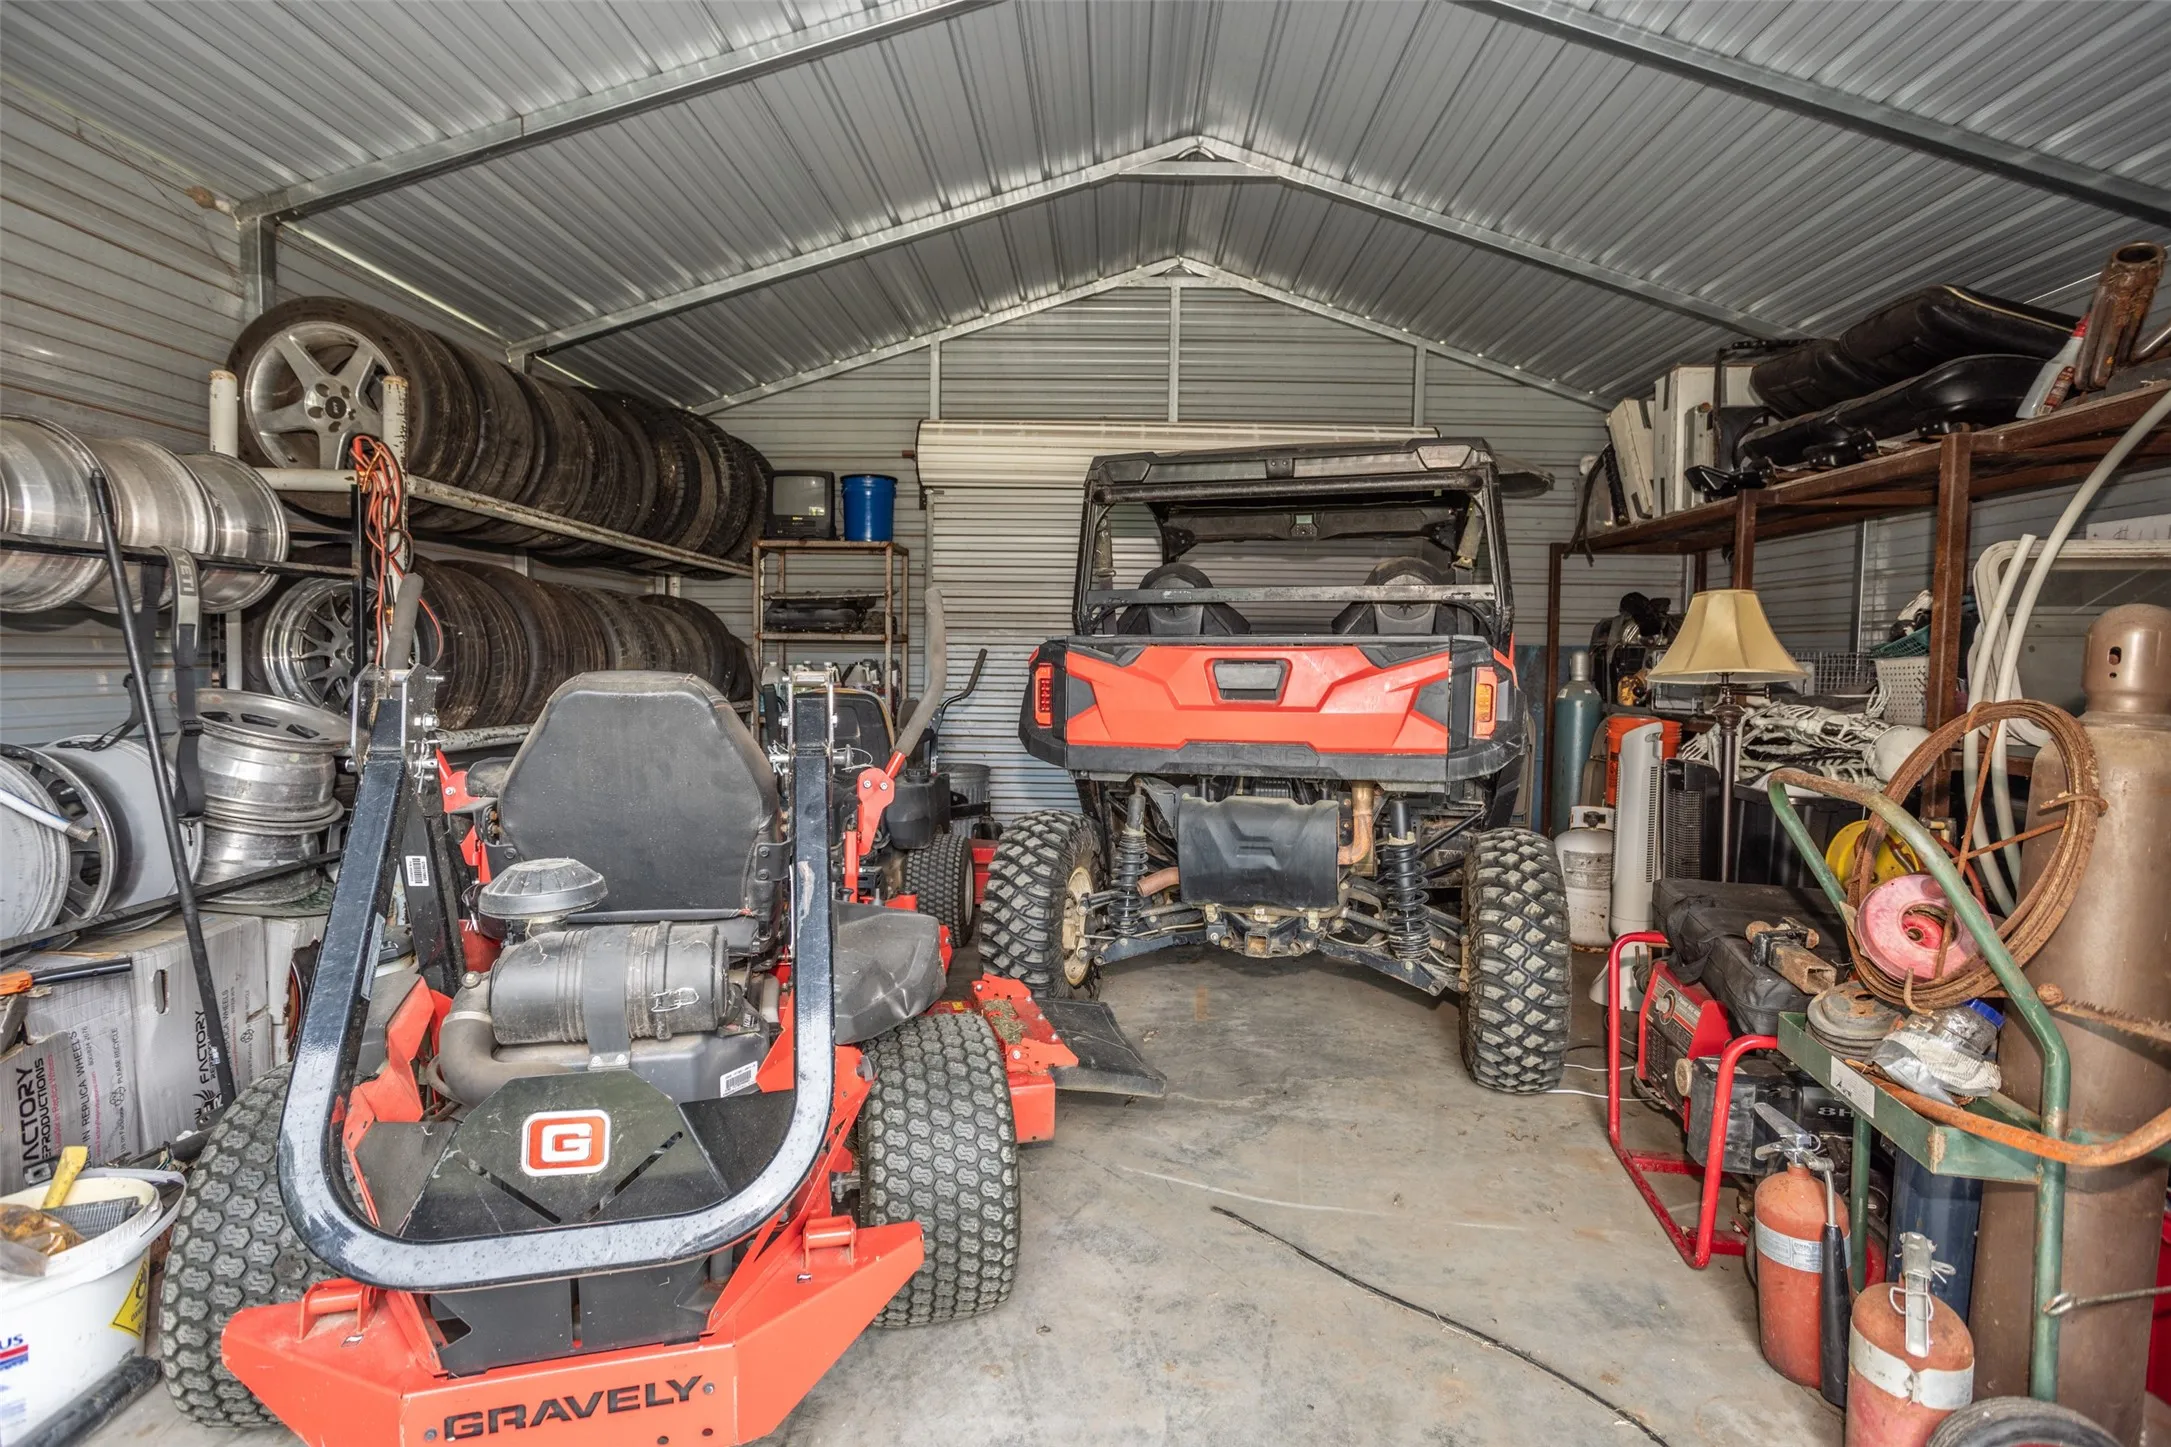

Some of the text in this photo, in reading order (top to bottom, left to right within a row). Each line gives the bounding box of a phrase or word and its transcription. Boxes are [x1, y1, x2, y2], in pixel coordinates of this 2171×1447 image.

[177, 554, 195, 592] YETI
[69, 1031, 85, 1077] WHEELS
[112, 1028, 120, 1057] RECYCLE
[195, 1011, 209, 1084] FACTORY
[16, 1068, 39, 1161] ACTORY
[35, 1058, 51, 1160] EPRODUCTIONS
[80, 1080, 90, 1125] REPLICA
[541, 1123, 592, 1163] G
[444, 1375, 703, 1441] GRAVELY
